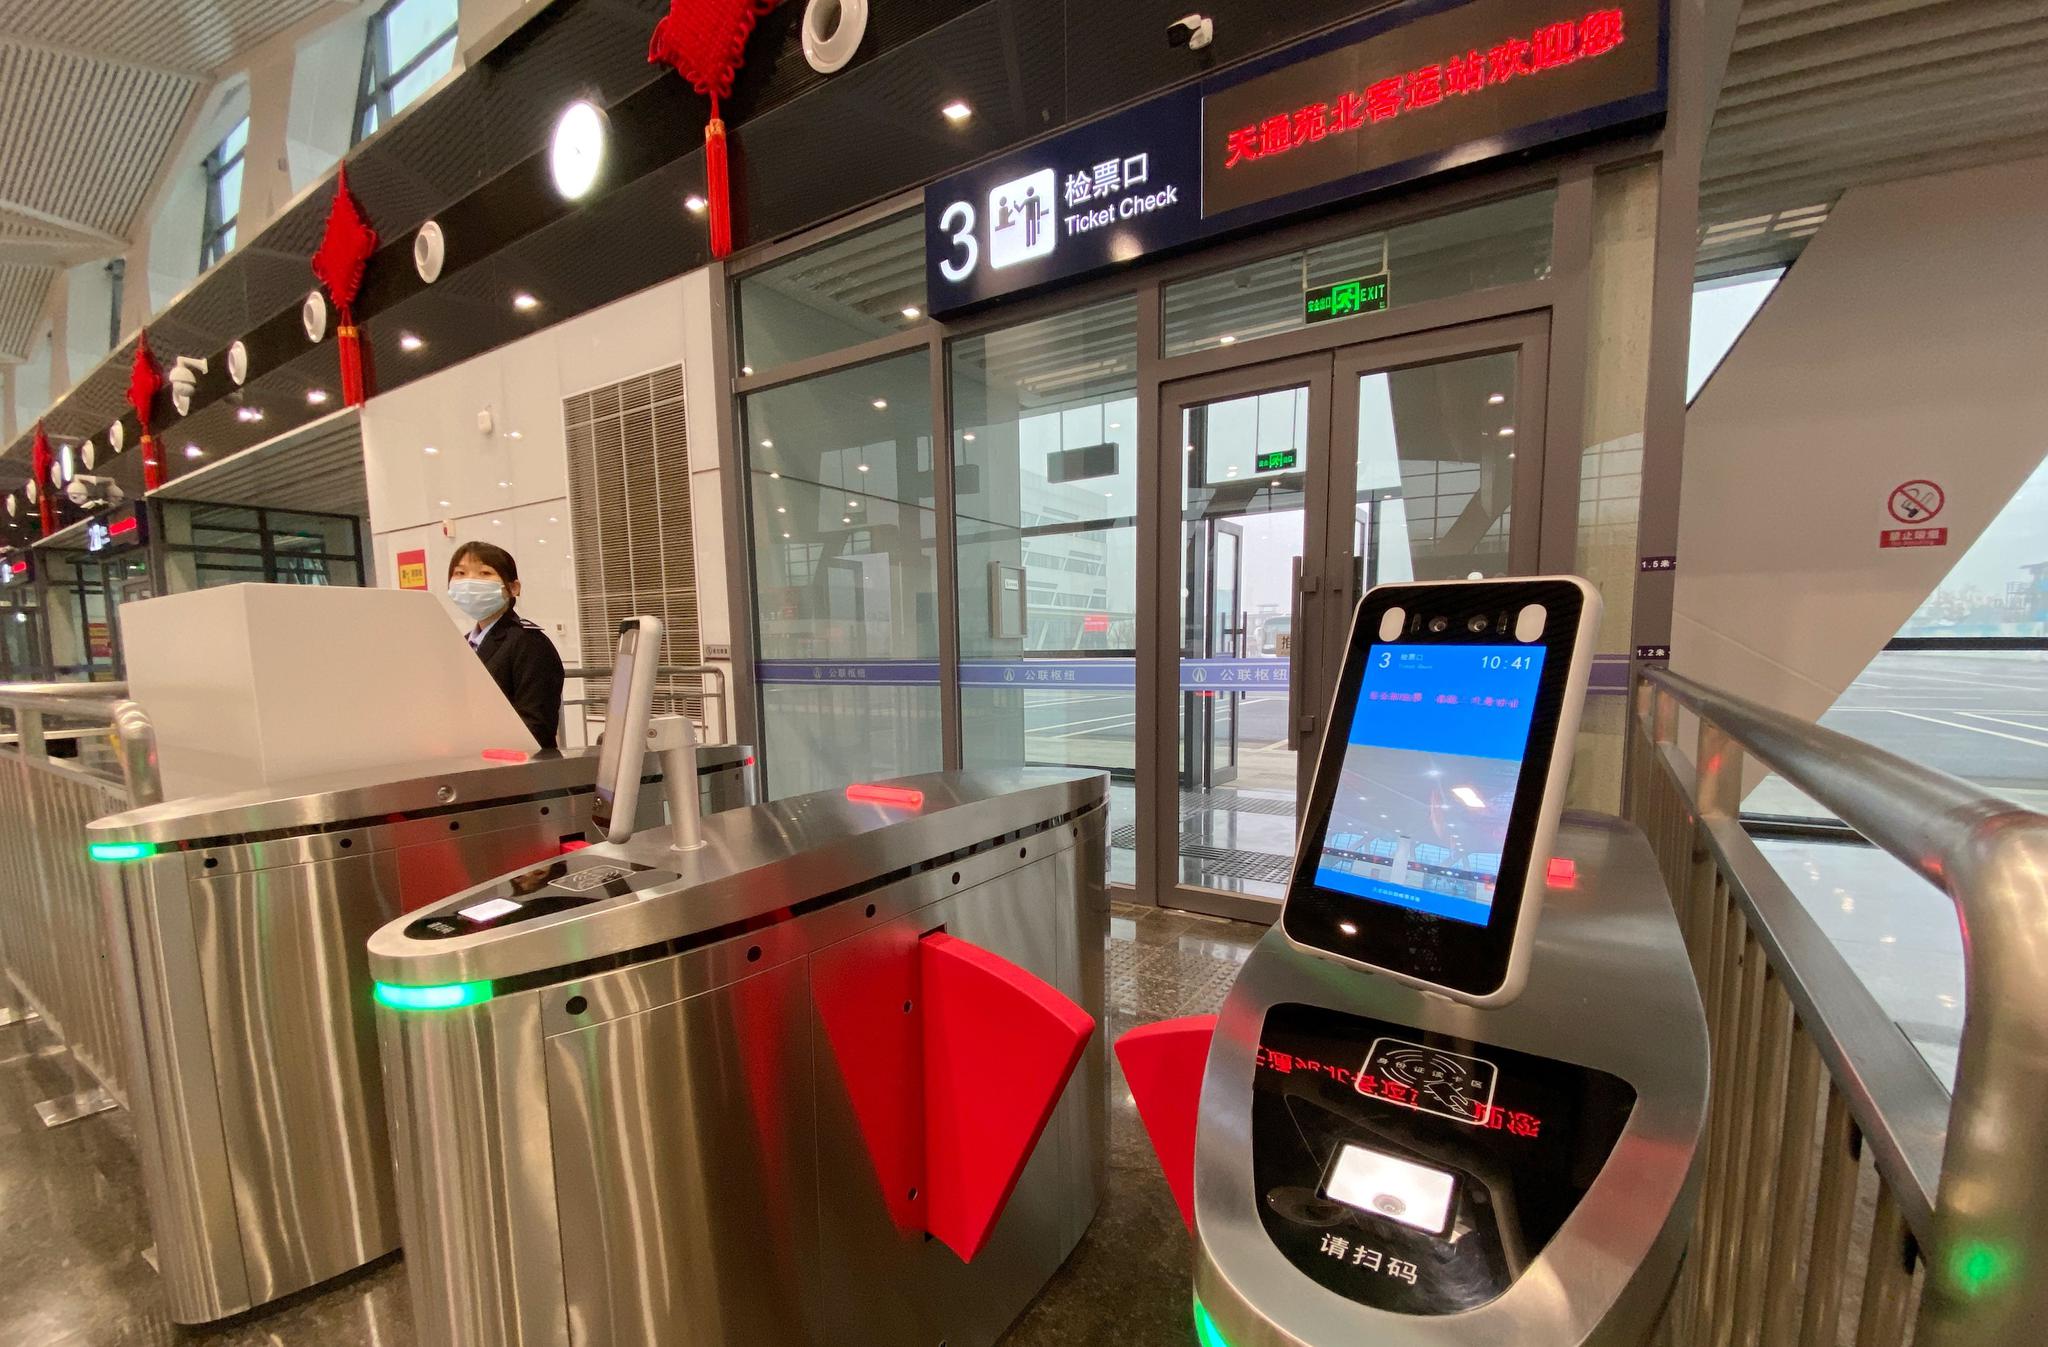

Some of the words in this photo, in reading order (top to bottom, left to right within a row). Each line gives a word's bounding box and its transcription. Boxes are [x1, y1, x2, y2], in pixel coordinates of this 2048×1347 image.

[1224, 9, 1624, 169] 天通苑北客运站欢迎您
[1064, 153, 1149, 208] 检票口
[1064, 203, 1116, 237] Ticket
[1119, 184, 1178, 219] Check
[939, 200, 979, 282] 3
[1360, 284, 1385, 302] EXIT
[1307, 297, 1331, 313] 安全出口
[1378, 652, 1392, 669] 3
[1481, 655, 1532, 671] 10:41
[1024, 669, 1076, 681] 公联枢纽
[1220, 668, 1288, 681] 公联枢纽
[1320, 1233, 1418, 1285] 请扫码
